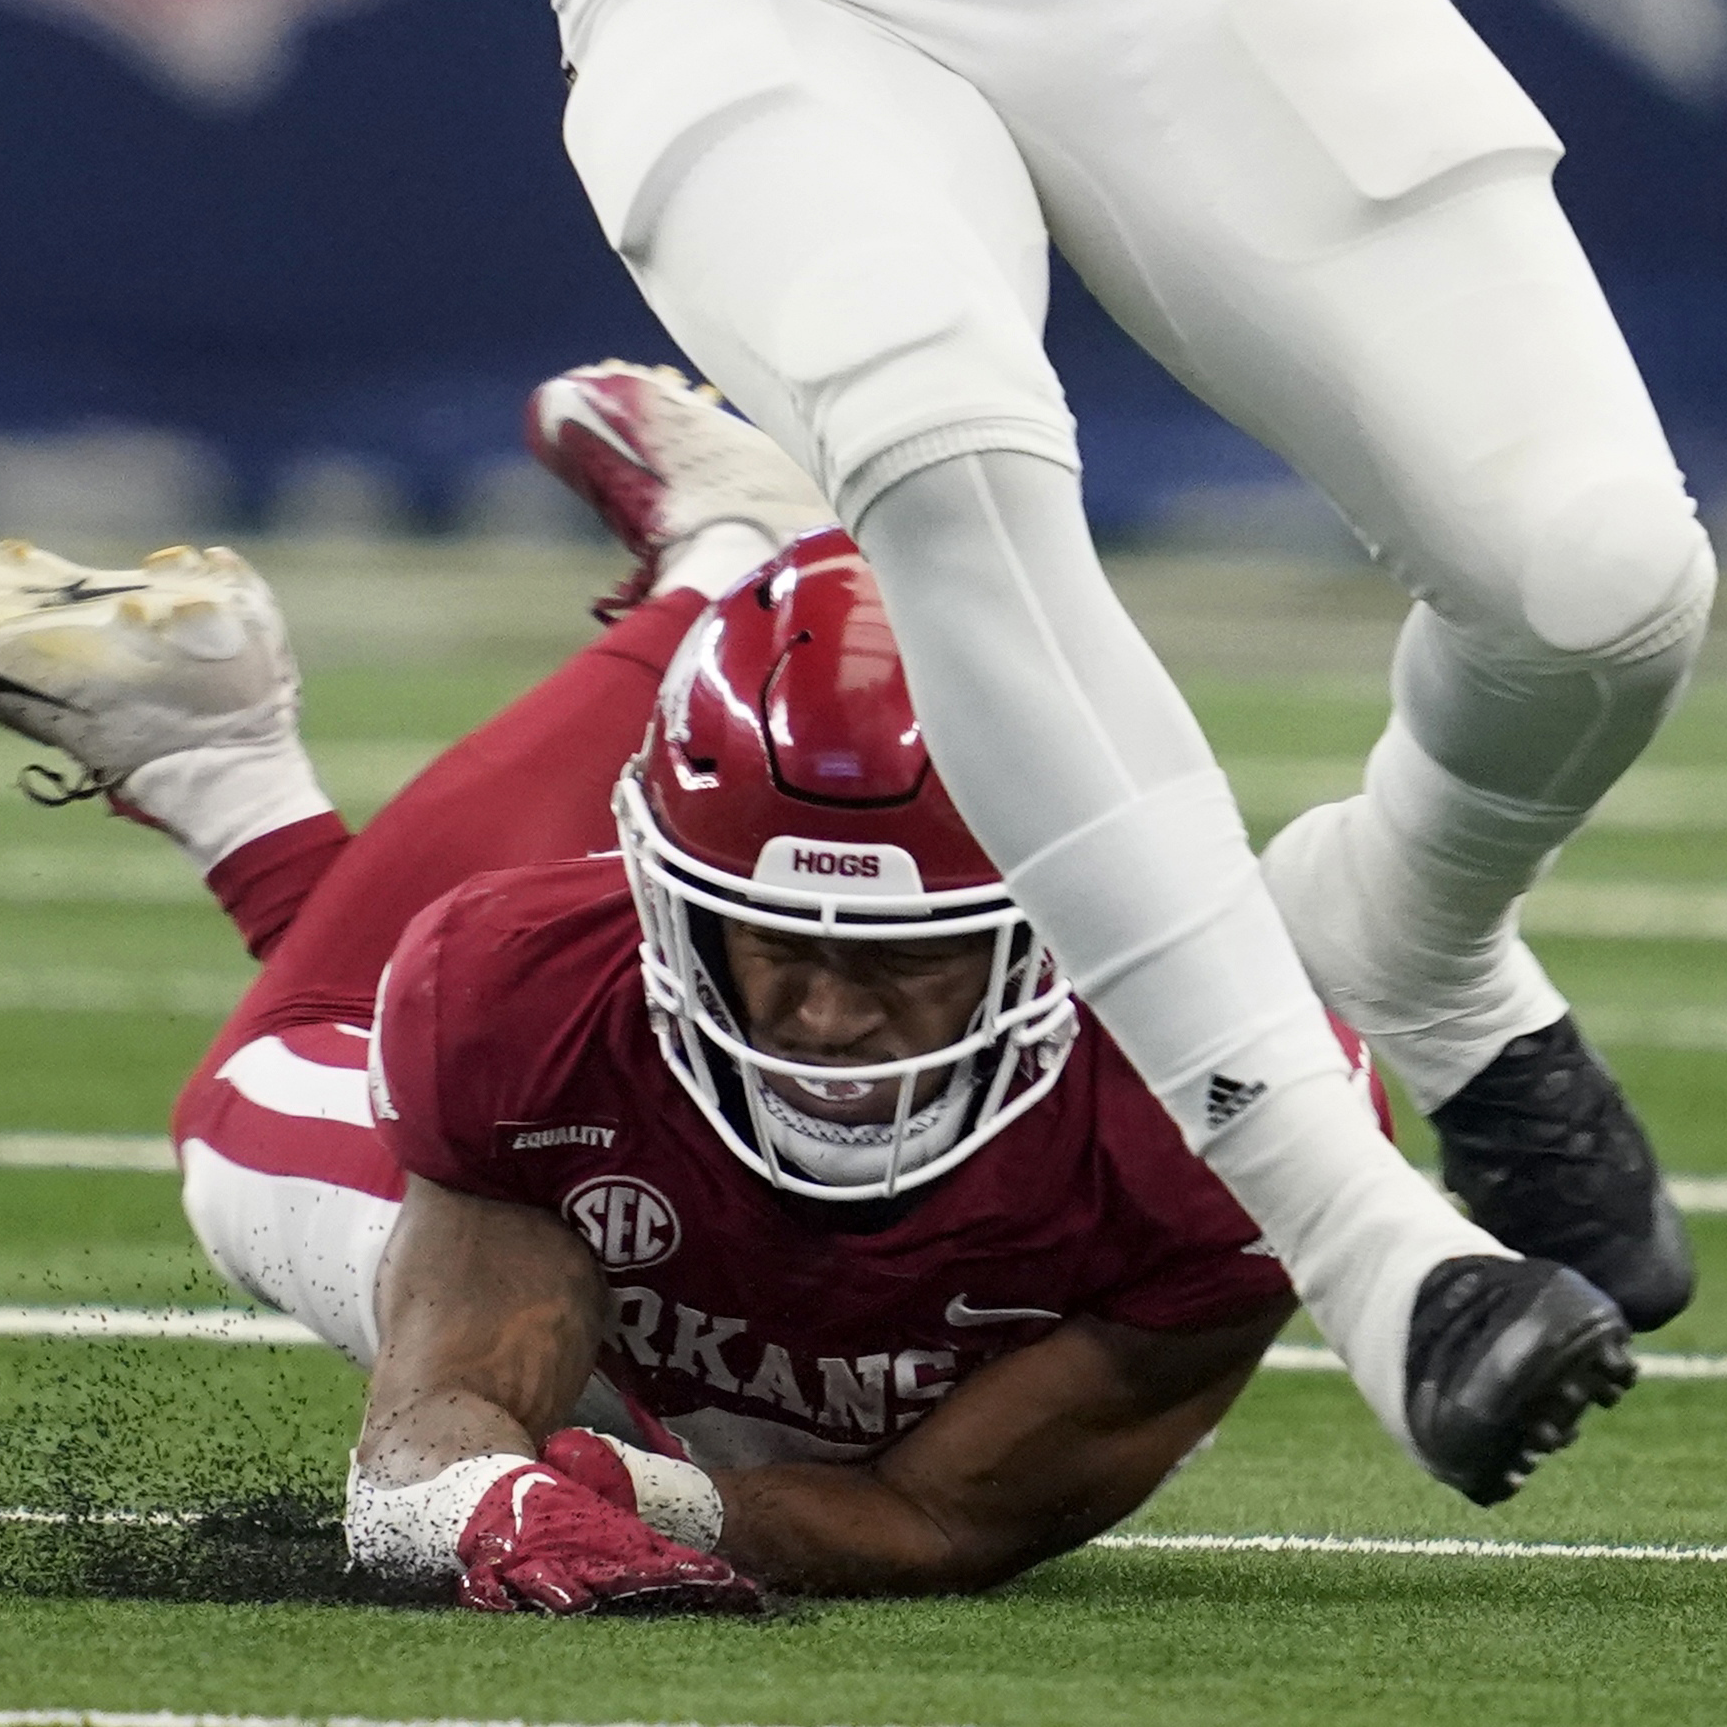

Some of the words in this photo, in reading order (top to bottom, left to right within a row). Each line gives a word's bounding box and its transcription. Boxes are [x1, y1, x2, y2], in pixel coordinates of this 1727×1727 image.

[792, 848, 881, 878] HOGS
[512, 1125, 616, 1150] EQUALITY
[572, 1185, 669, 1265] SEC
[601, 1285, 956, 1434] RKANS
